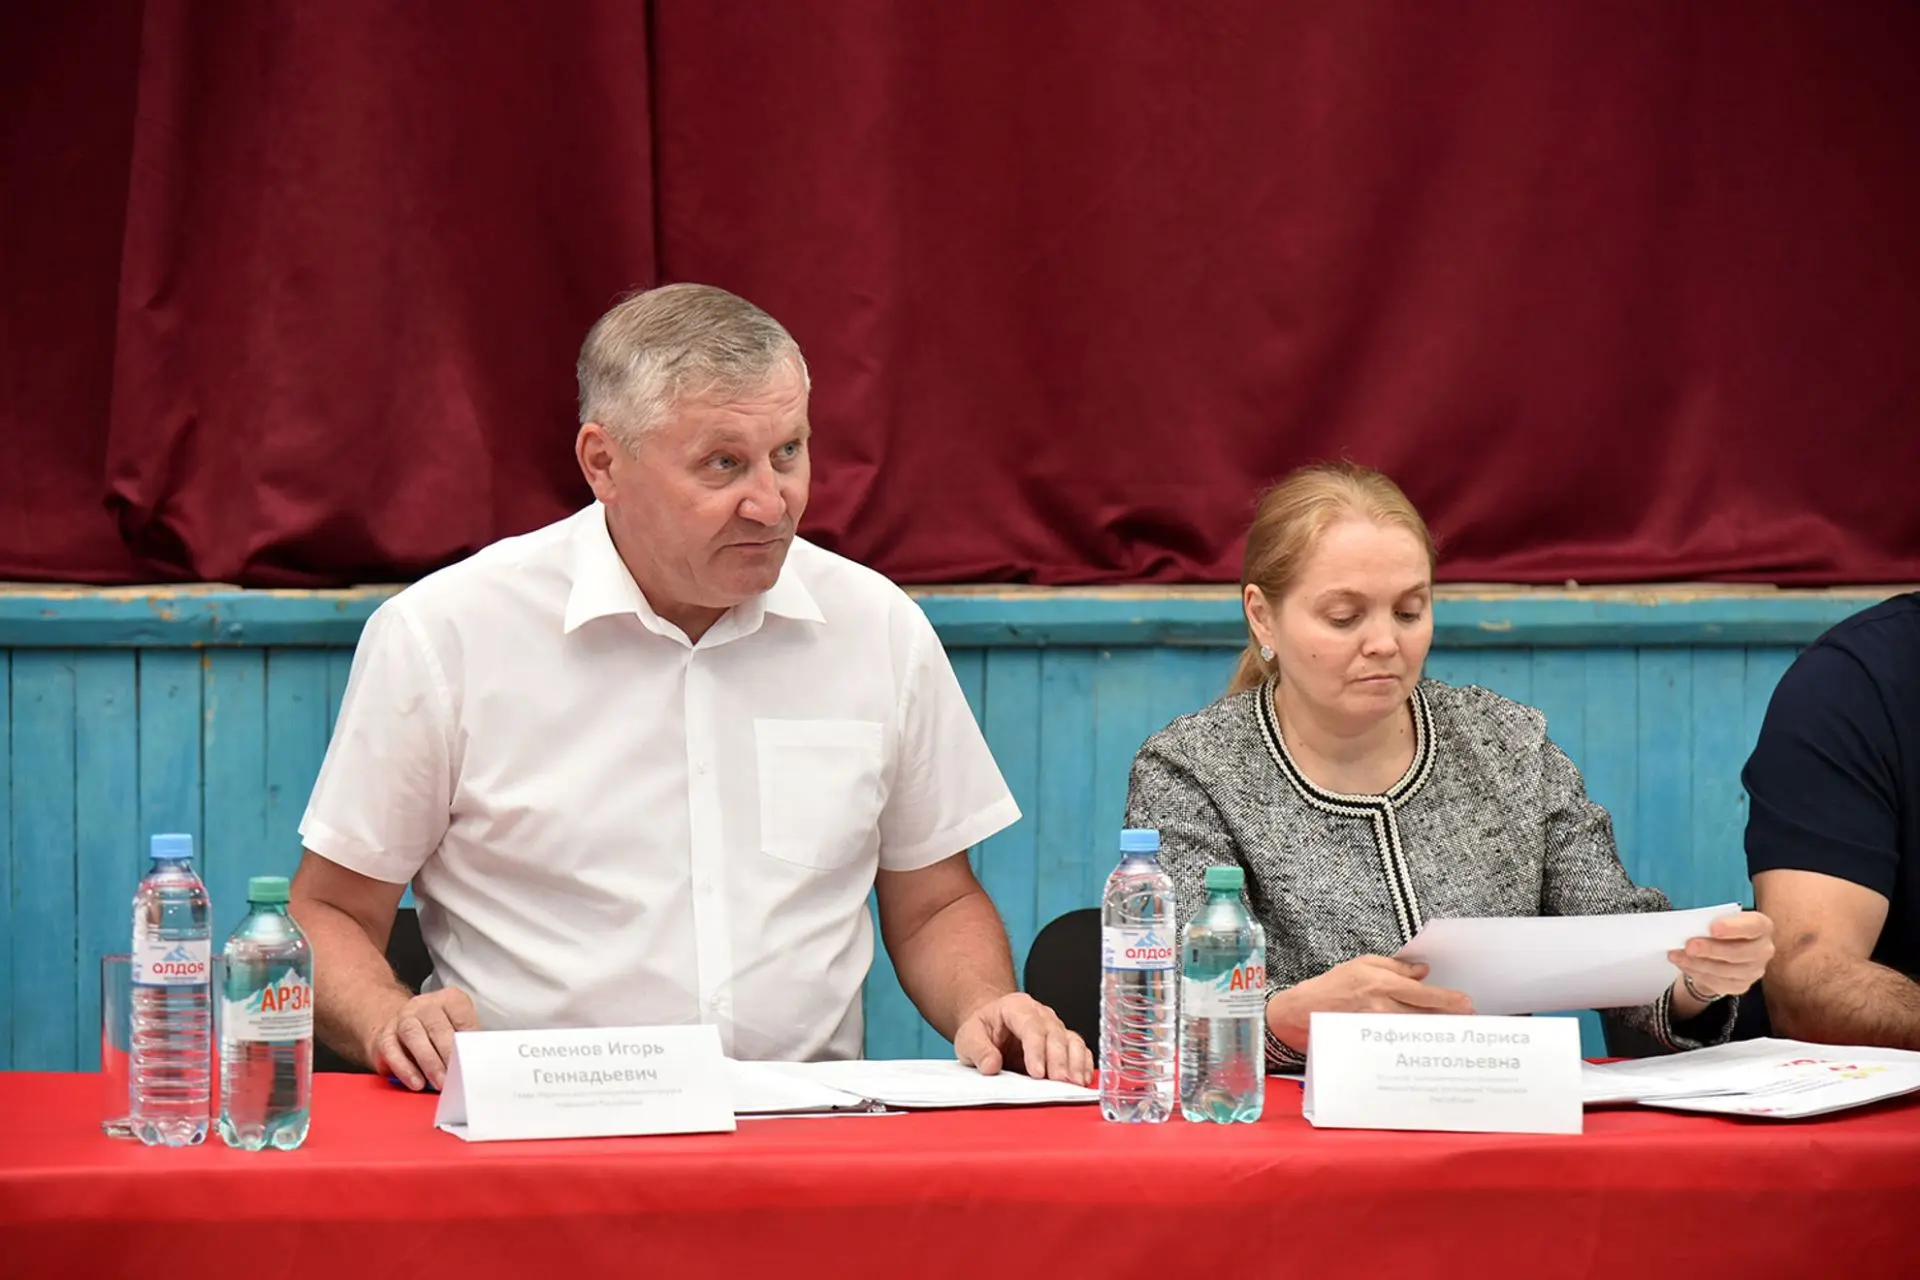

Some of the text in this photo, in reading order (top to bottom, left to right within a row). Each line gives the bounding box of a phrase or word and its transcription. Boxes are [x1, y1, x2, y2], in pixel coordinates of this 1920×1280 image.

[1360, 1028, 1531, 1046] Рафикова Лариса
[518, 1041, 665, 1058] Семенов Игорь
[1395, 1053, 1521, 1069] Анатольевна
[533, 1067, 658, 1085] Геннадьевич
